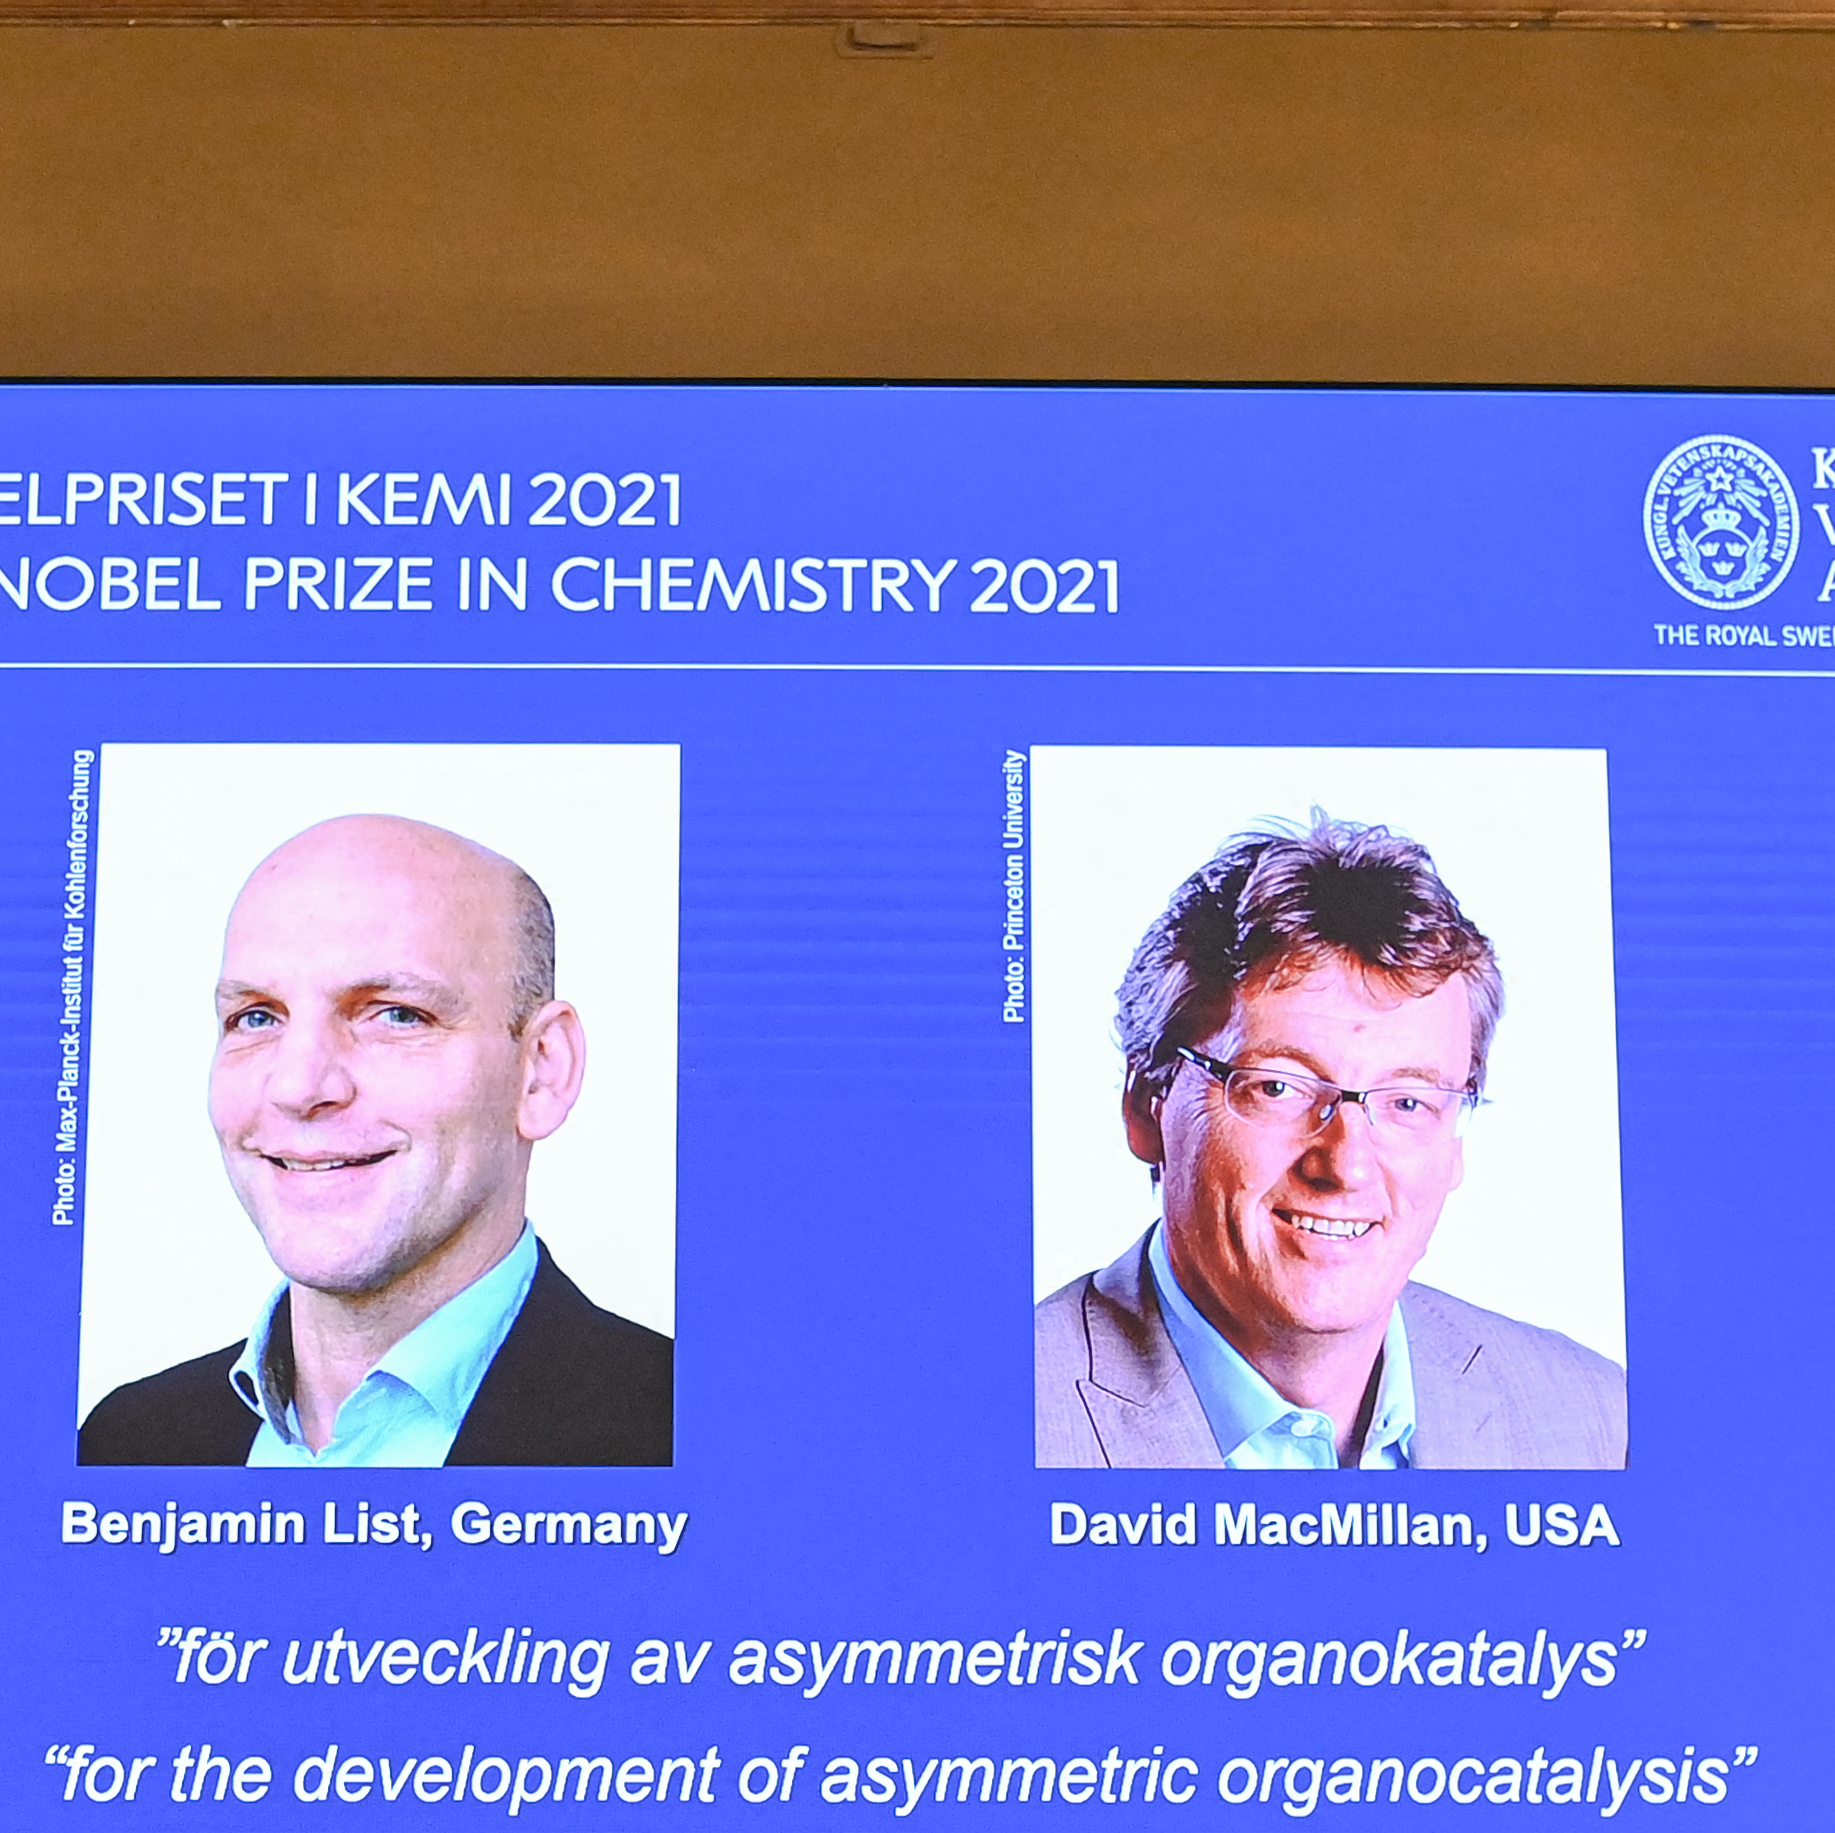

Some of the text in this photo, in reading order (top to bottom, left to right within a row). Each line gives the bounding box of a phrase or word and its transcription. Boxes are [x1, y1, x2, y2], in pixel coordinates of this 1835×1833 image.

[306, 473, 317, 525] I
[338, 472, 511, 525] KEMI
[529, 472, 680, 527] 2021
[246, 557, 433, 610] PRIZE
[459, 557, 527, 611] IN
[552, 556, 958, 612] CHEMISTRY
[970, 558, 1118, 614] 2021
[1654, 624, 1700, 646] THE
[1706, 625, 1778, 646] ROYAL
[1002, 749, 1027, 1023] Photo: Princeton University
[52, 750, 95, 1225] Photo: Max-Planck-Institut für Kohlenforschung
[62, 1501, 688, 1555] Benjamin List, Germany
[1051, 1502, 1620, 1554] David MacMillan, USA
[283, 1627, 611, 1698] utveckling
[631, 1639, 713, 1685] av
[729, 1628, 1145, 1699] asymmetrisk
[171, 1744, 272, 1802] the
[294, 1744, 722, 1816] development
[739, 1745, 810, 1803] of
[821, 1745, 1199, 1817] asymmetric
